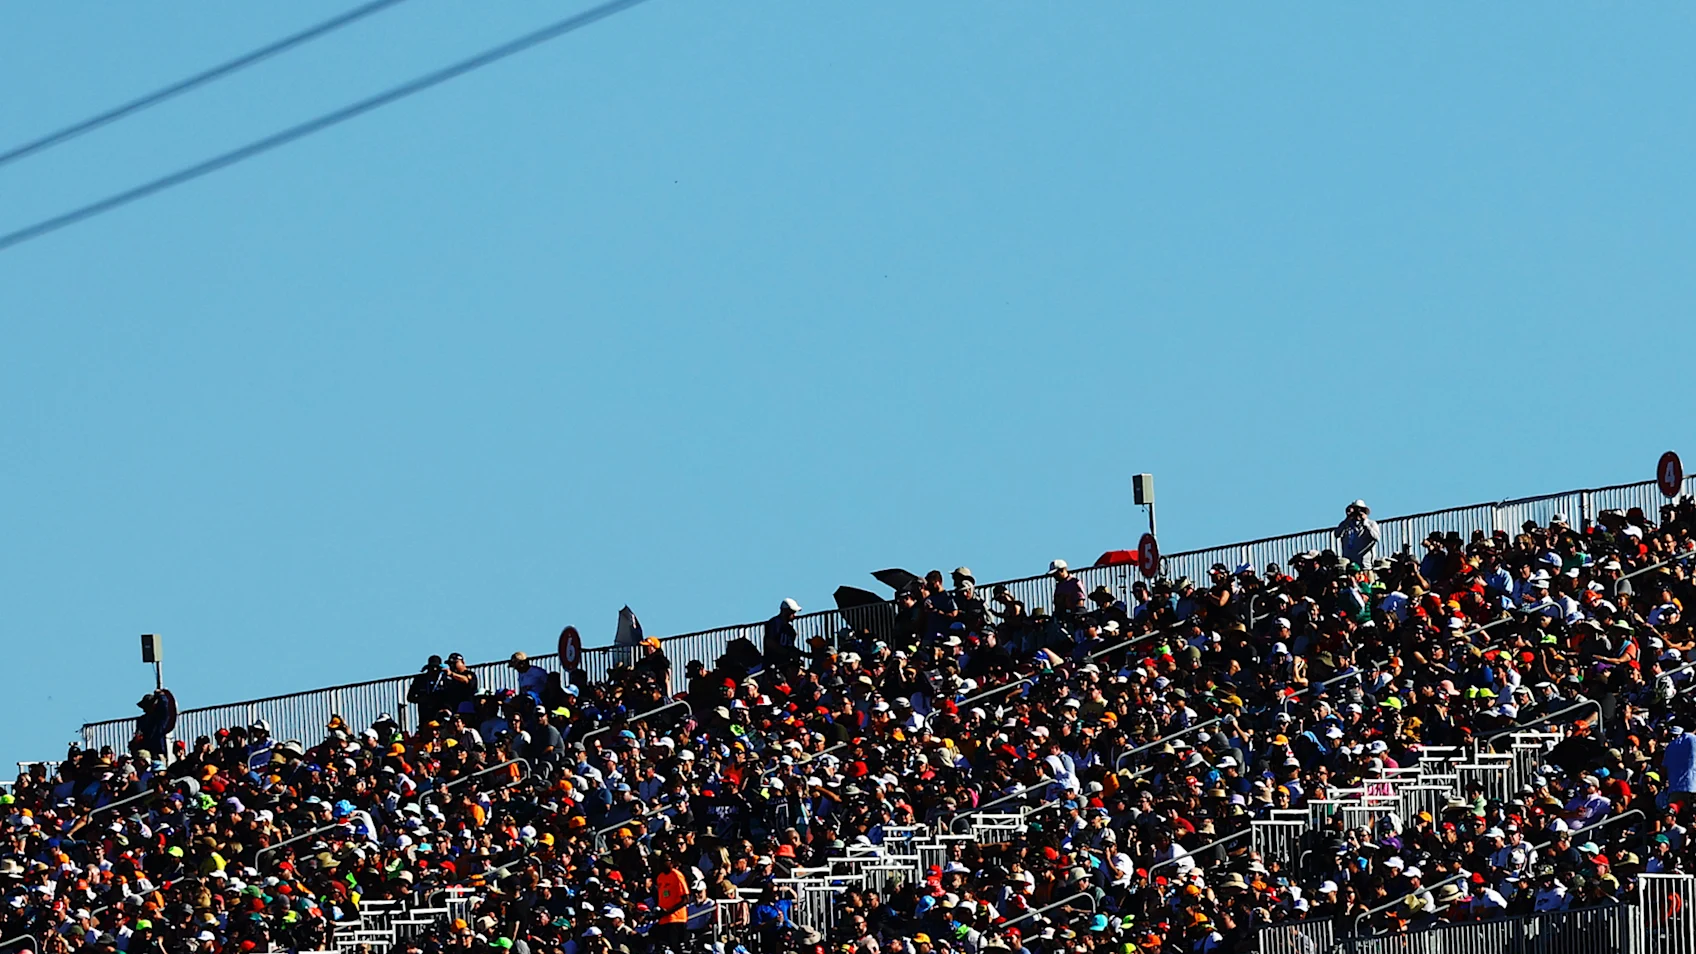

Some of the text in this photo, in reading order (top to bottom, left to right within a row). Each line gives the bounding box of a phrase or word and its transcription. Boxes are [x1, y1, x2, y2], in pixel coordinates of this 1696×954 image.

[1665, 461, 1675, 487] 4
[1145, 543, 1153, 570] 5
[566, 637, 575, 662] 6
